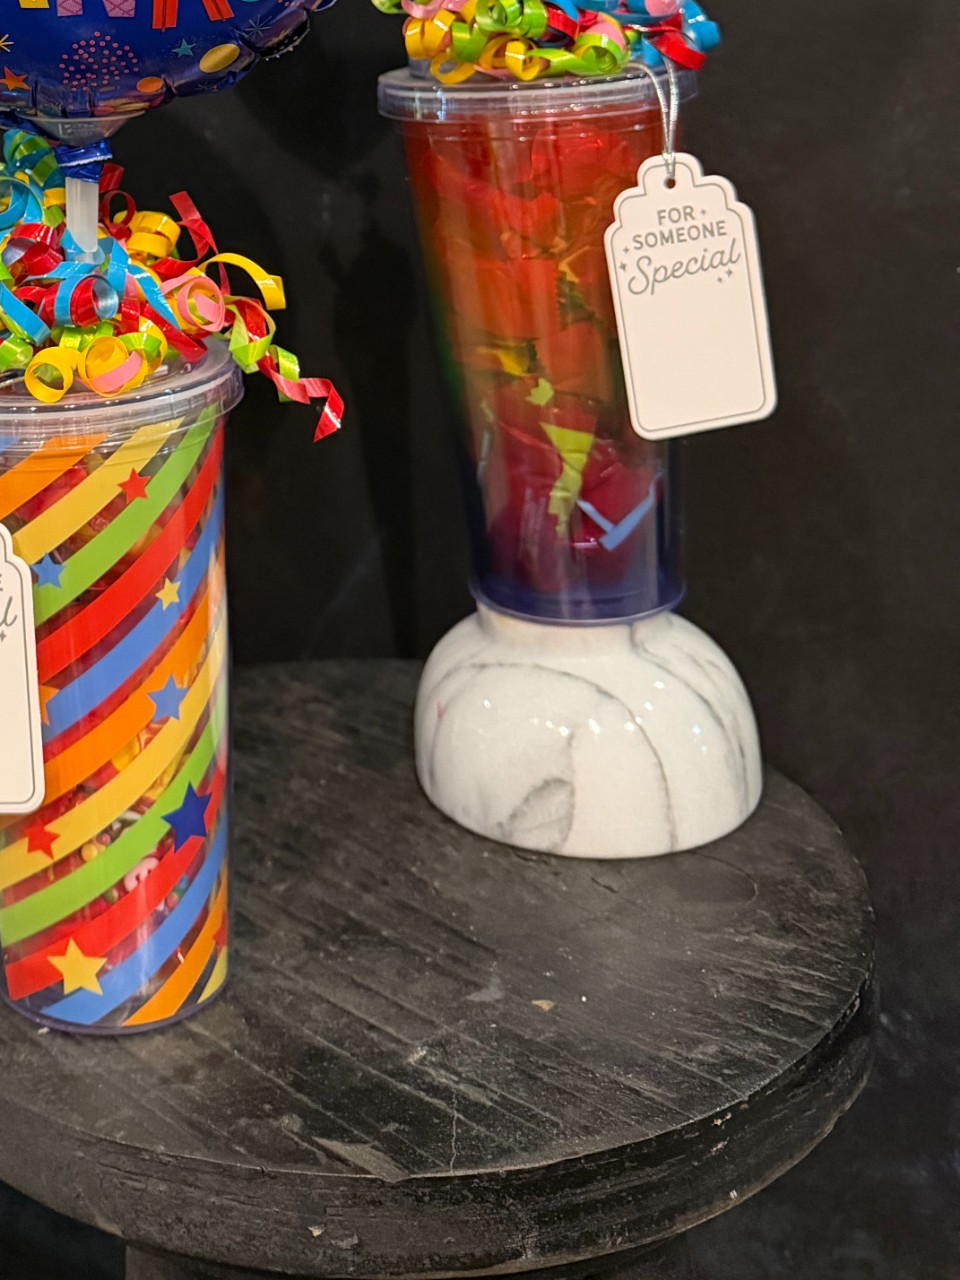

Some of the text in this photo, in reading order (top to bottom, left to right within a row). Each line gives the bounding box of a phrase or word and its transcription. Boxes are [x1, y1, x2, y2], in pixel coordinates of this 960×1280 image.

[656, 205, 696, 226] FOR
[632, 220, 727, 250] SOMEONE
[628, 238, 741, 295] Special
